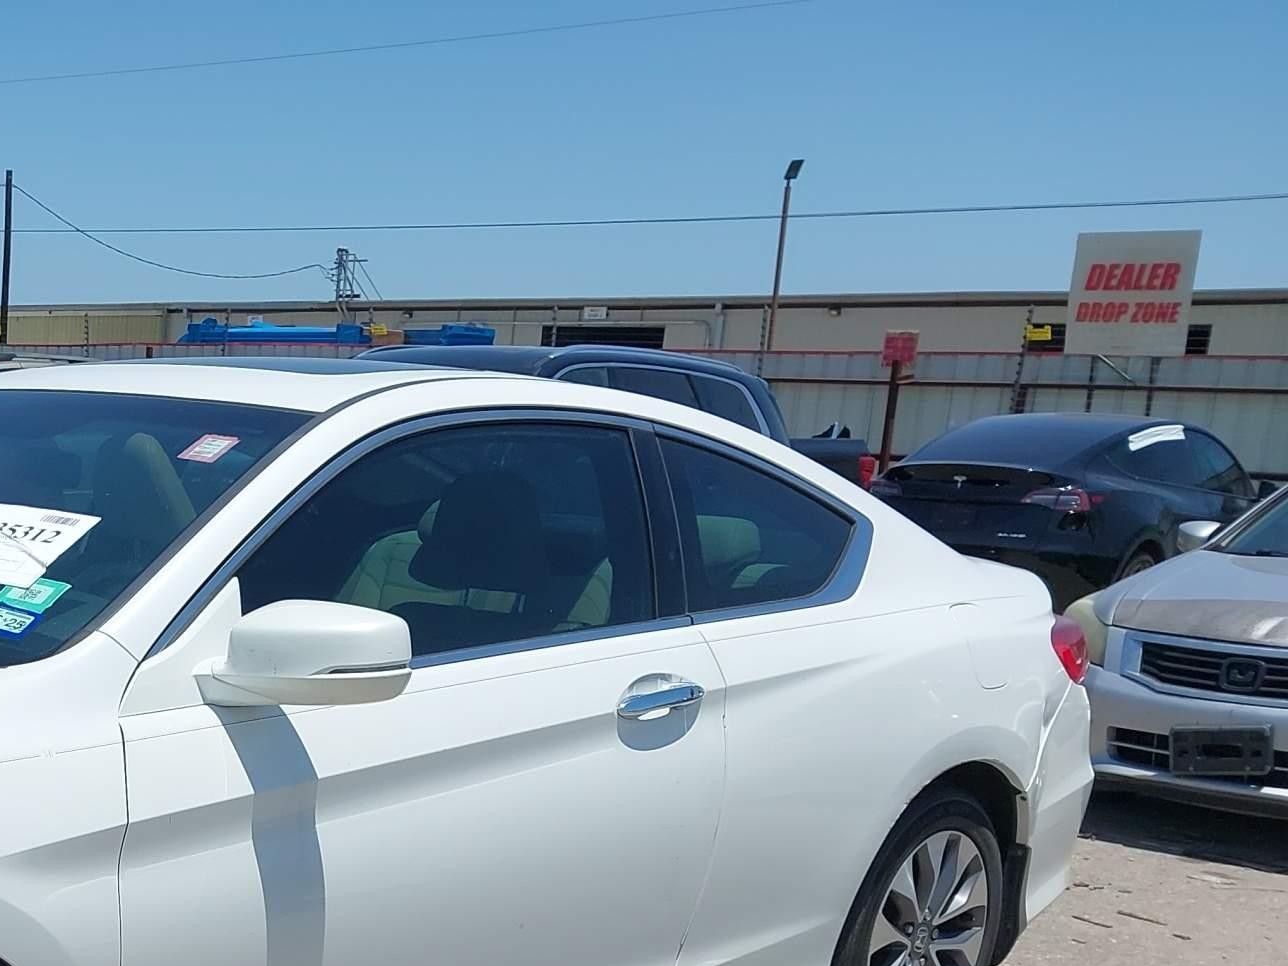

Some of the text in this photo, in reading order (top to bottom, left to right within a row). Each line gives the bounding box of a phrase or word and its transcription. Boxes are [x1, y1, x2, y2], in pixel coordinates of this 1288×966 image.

[1085, 263, 1181, 291] DEALER
[1075, 302, 1182, 323] DROP ZONE
